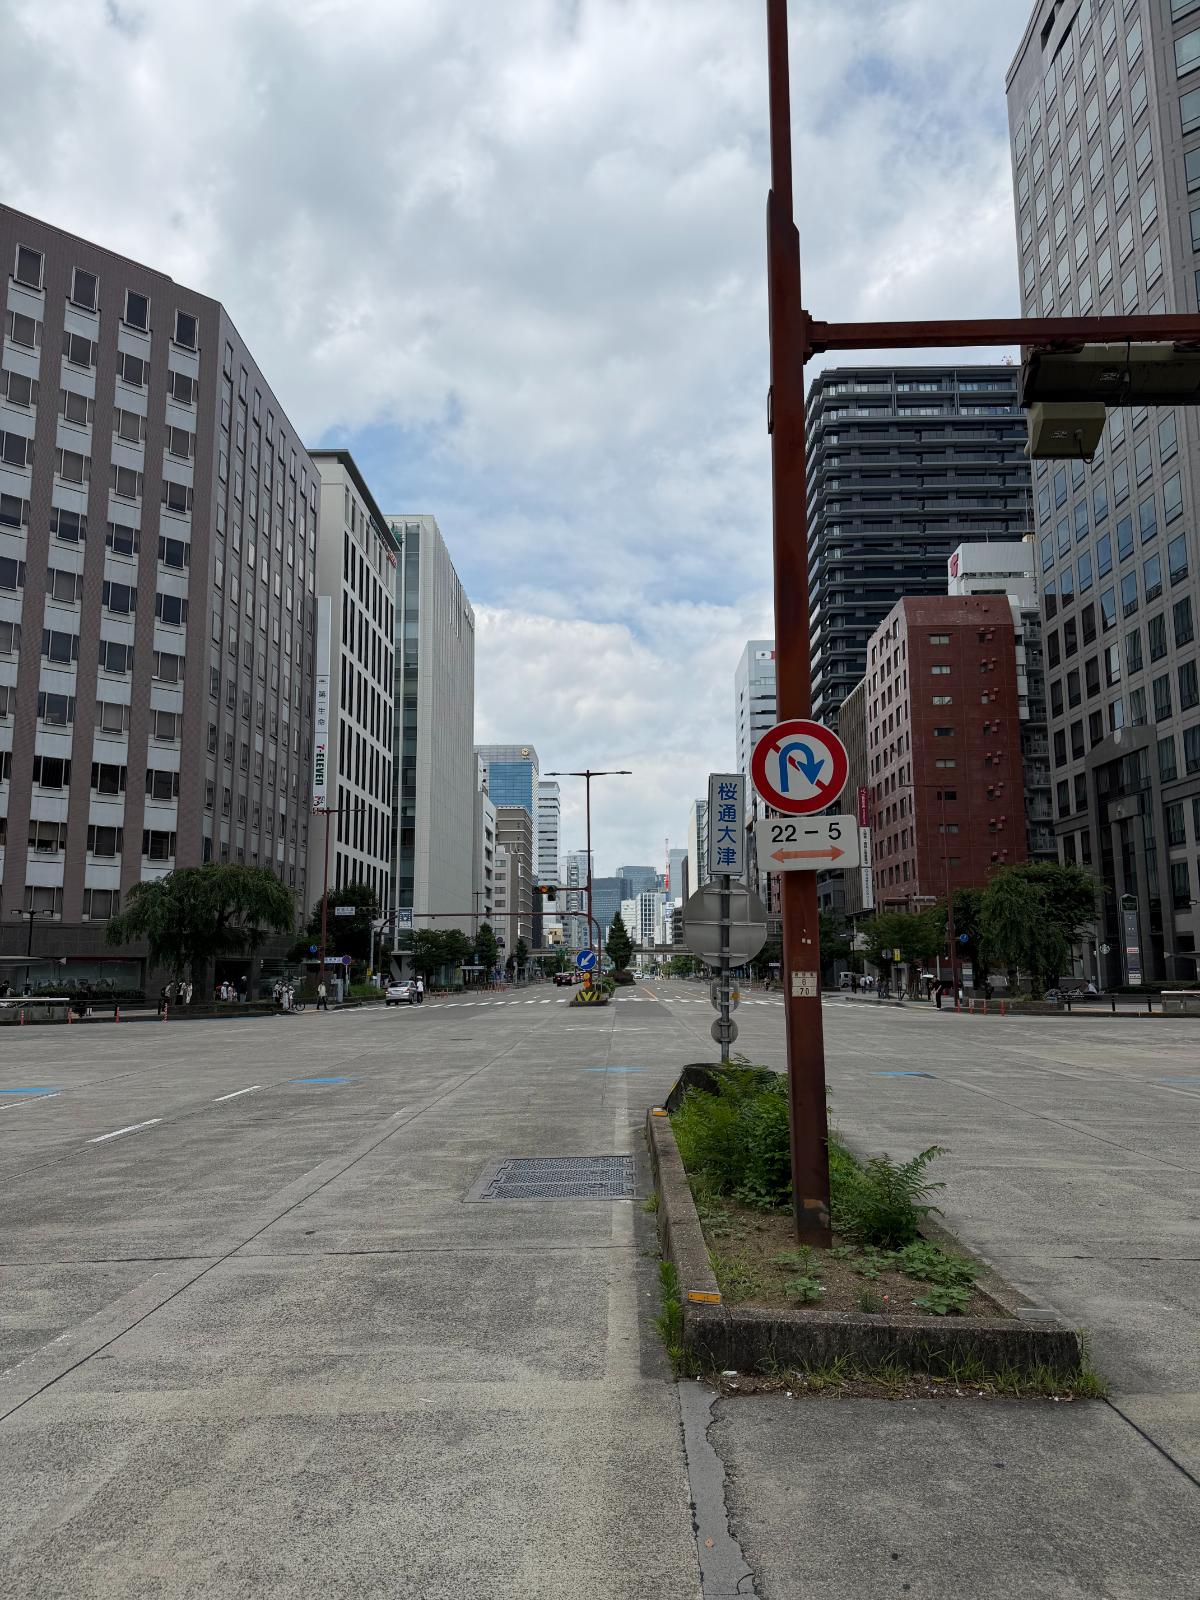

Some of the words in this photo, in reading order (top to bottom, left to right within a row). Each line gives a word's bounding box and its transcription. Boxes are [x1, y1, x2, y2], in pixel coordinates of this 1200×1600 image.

[717, 782, 737, 866] 桜通大津
[799, 987, 810, 996] 70
